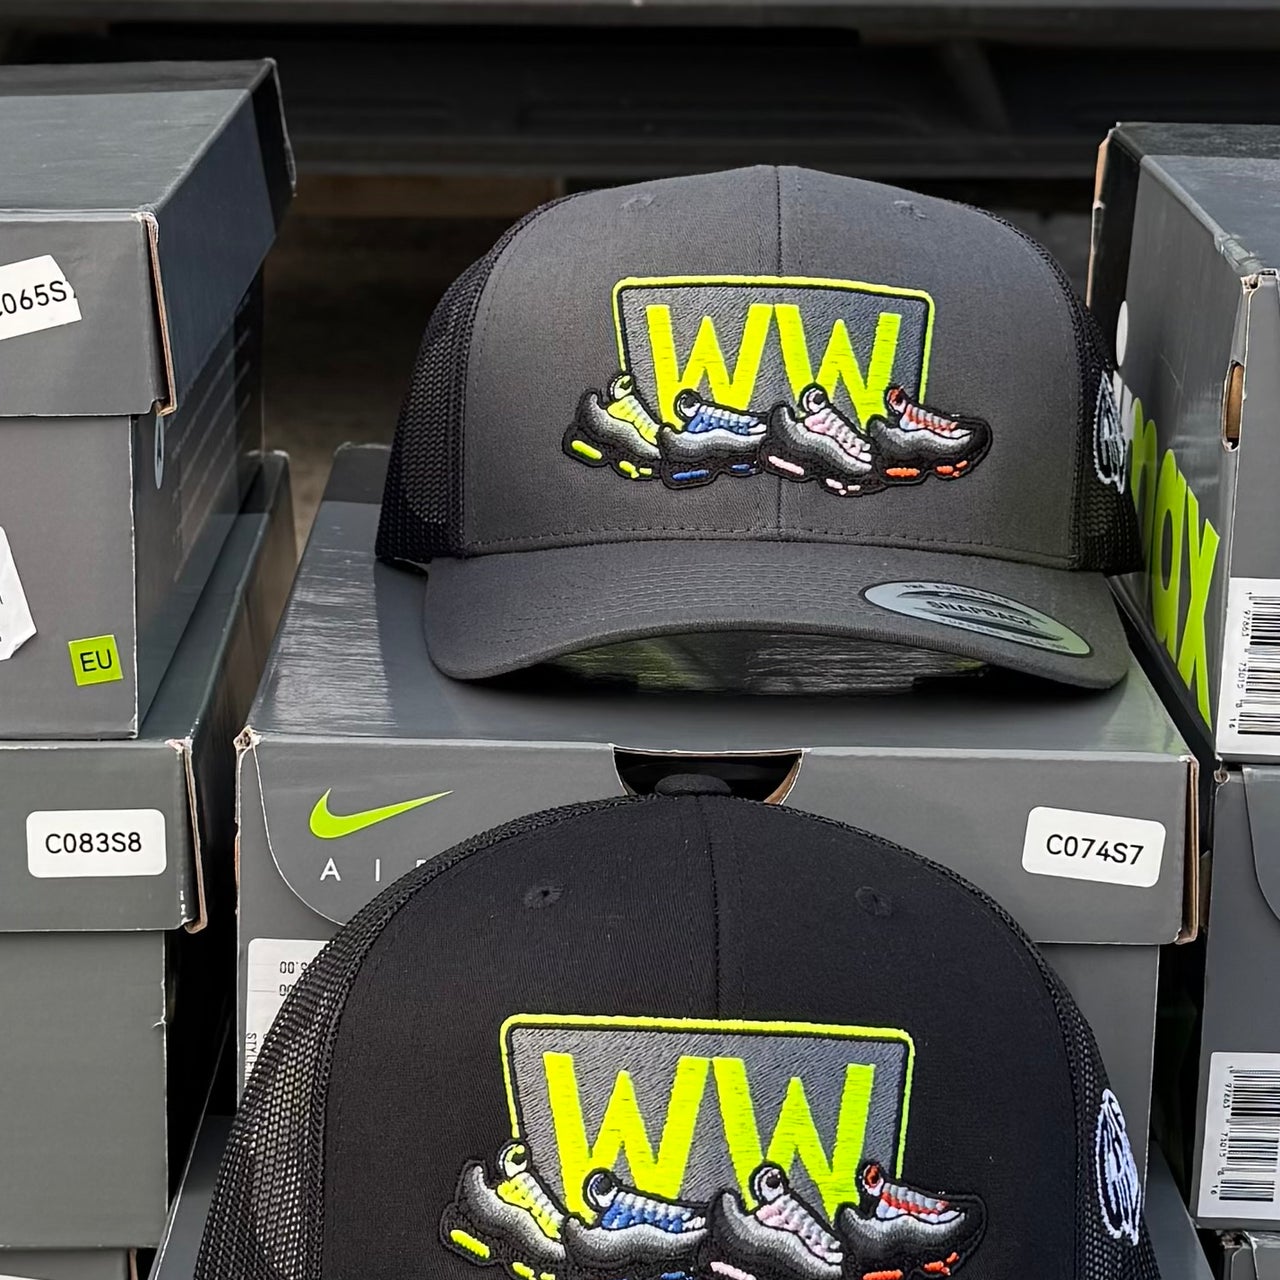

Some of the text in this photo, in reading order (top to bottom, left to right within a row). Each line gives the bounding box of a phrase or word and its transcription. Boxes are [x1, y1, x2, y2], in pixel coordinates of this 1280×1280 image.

[647, 302, 901, 430] WW
[926, 600, 1039, 629] SNAPBACK
[80, 649, 113, 673] EU
[45, 831, 142, 854] C083S8
[1046, 833, 1144, 865] C074S7
[320, 858, 427, 881] AI
[542, 1051, 876, 1225] WW
